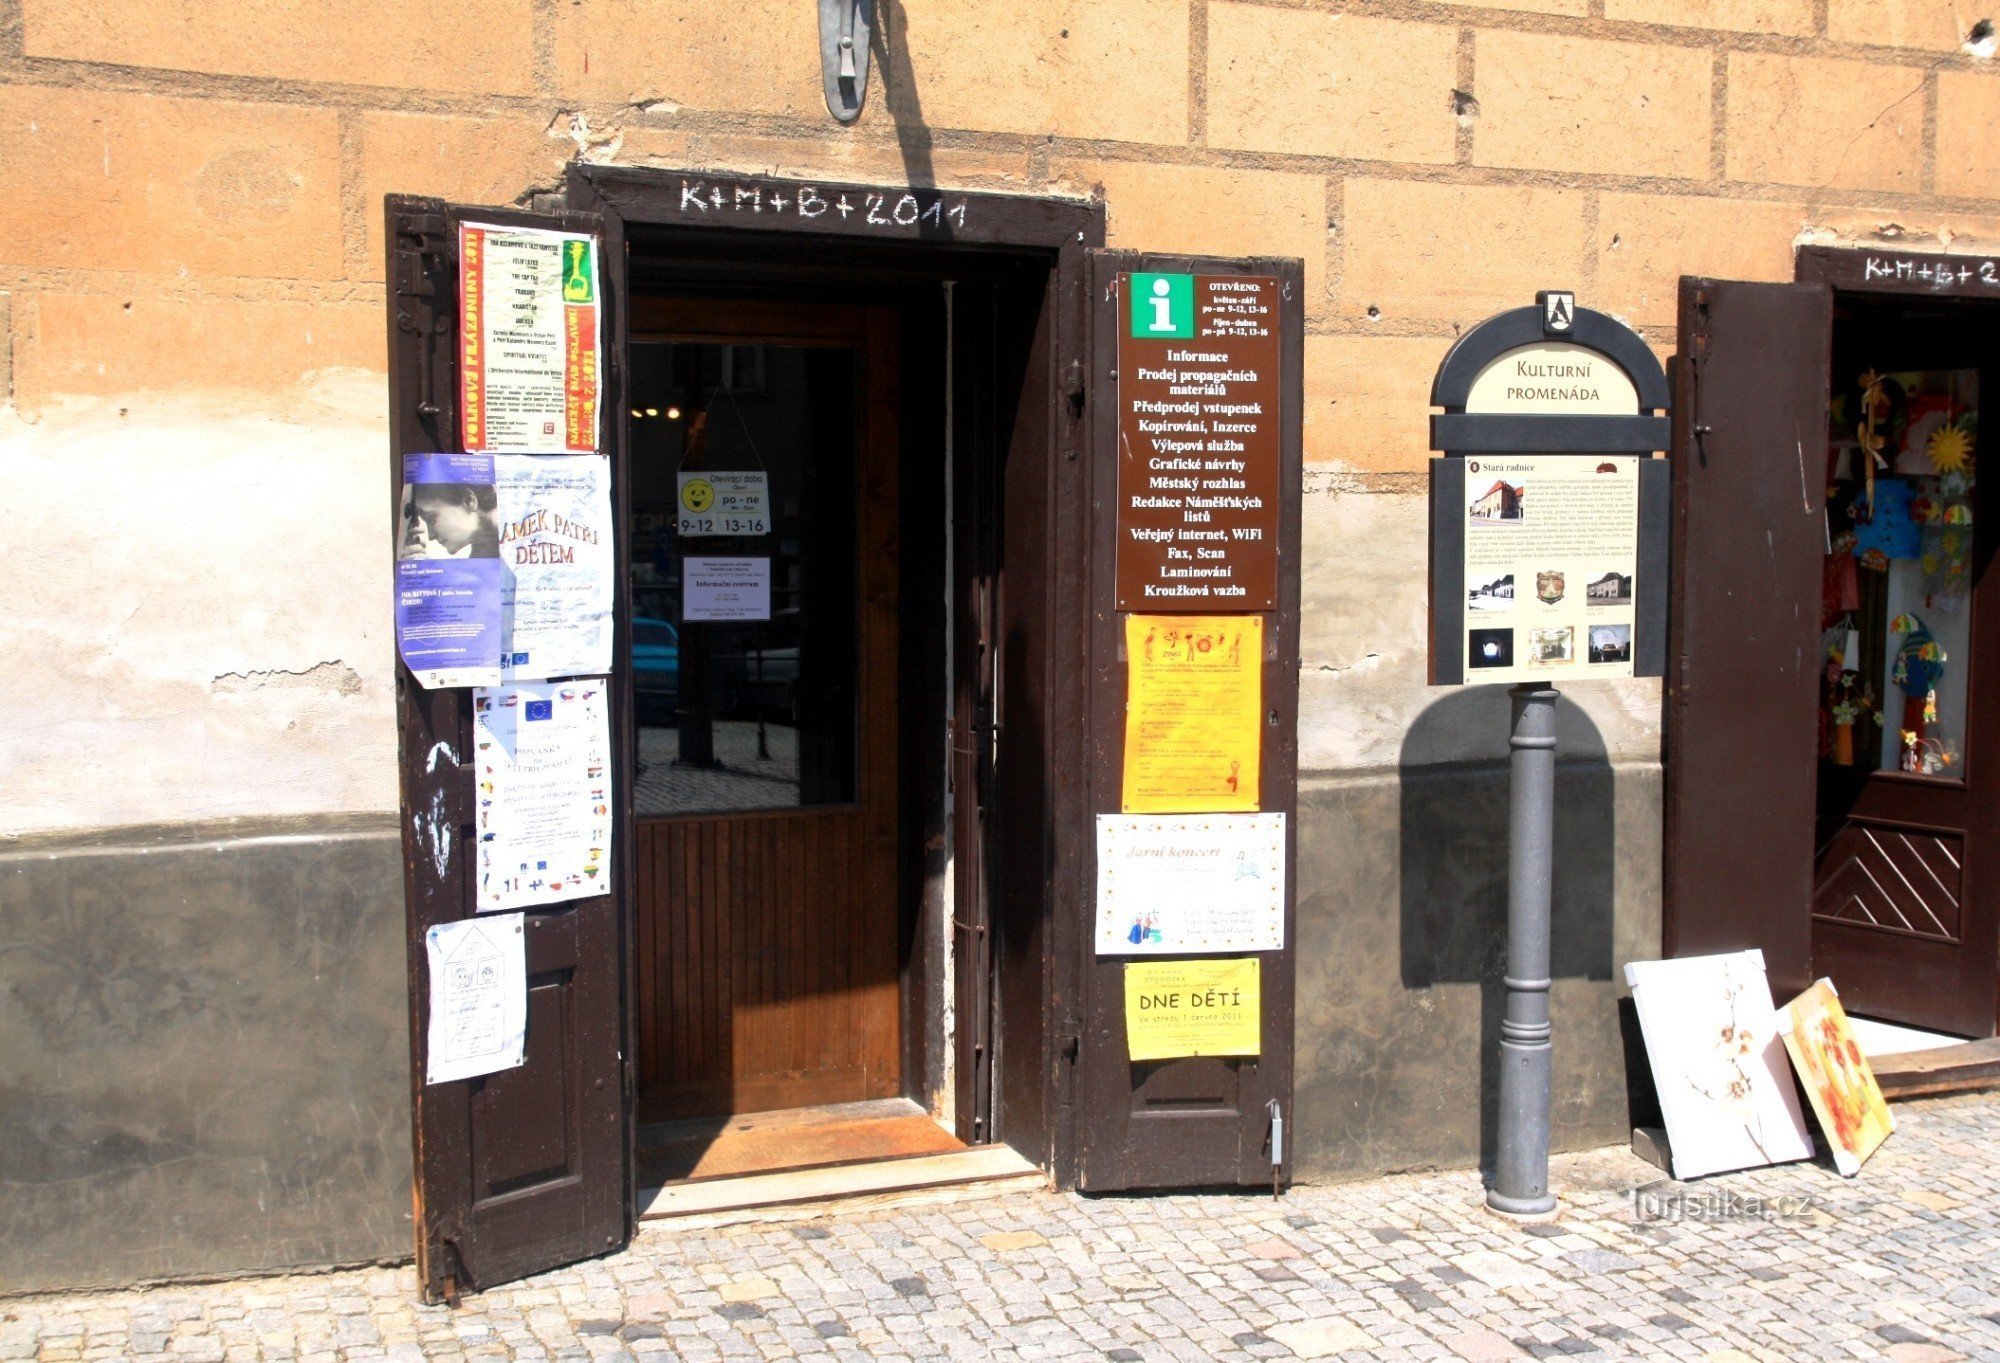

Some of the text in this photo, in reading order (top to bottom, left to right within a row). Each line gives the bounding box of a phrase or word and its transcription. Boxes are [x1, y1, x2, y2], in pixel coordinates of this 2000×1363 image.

[1209, 281, 1261, 292] OTEVŘENO:
[1248, 305, 1268, 314] 13-16
[1249, 328, 1269, 337] 13-16
[1167, 349, 1229, 363] Informace
[1137, 368, 1258, 384] Prodej propagačních
[1169, 383, 1227, 396] materiálů
[1506, 384, 1601, 401] PROMENÁDA
[1132, 400, 1262, 417] Předprodej vstupenek
[1138, 419, 1257, 435] Kopírování, Inzerce
[1151, 438, 1245, 454] Výlepová služba
[1149, 457, 1246, 473] Grafické návrhy
[1482, 462, 1504, 472] Stará
[1506, 462, 1536, 472] radnice
[1149, 476, 1246, 492] Městský rozhlas
[722, 497, 737, 505] po
[746, 496, 760, 504] ne
[1131, 495, 1262, 511] Redakce Náměšťských
[1183, 510, 1211, 523] listů
[681, 519, 764, 532] 9-12 13-16
[1130, 528, 1262, 543] Veřejný internet, WiFi
[516, 540, 575, 565] DĚTEM
[1167, 547, 1226, 561] Fax, Scan
[1160, 565, 1232, 578] Laminování
[696, 580, 731, 588] Informační
[1144, 584, 1246, 597] Kroužková vazba
[1169, 847, 1222, 858] koncert
[1140, 987, 1241, 1010] DNE DĚTÍ
[1152, 1014, 1179, 1023] středu
[1190, 1013, 1218, 1021] června
[1221, 1012, 1242, 1020] 2011
